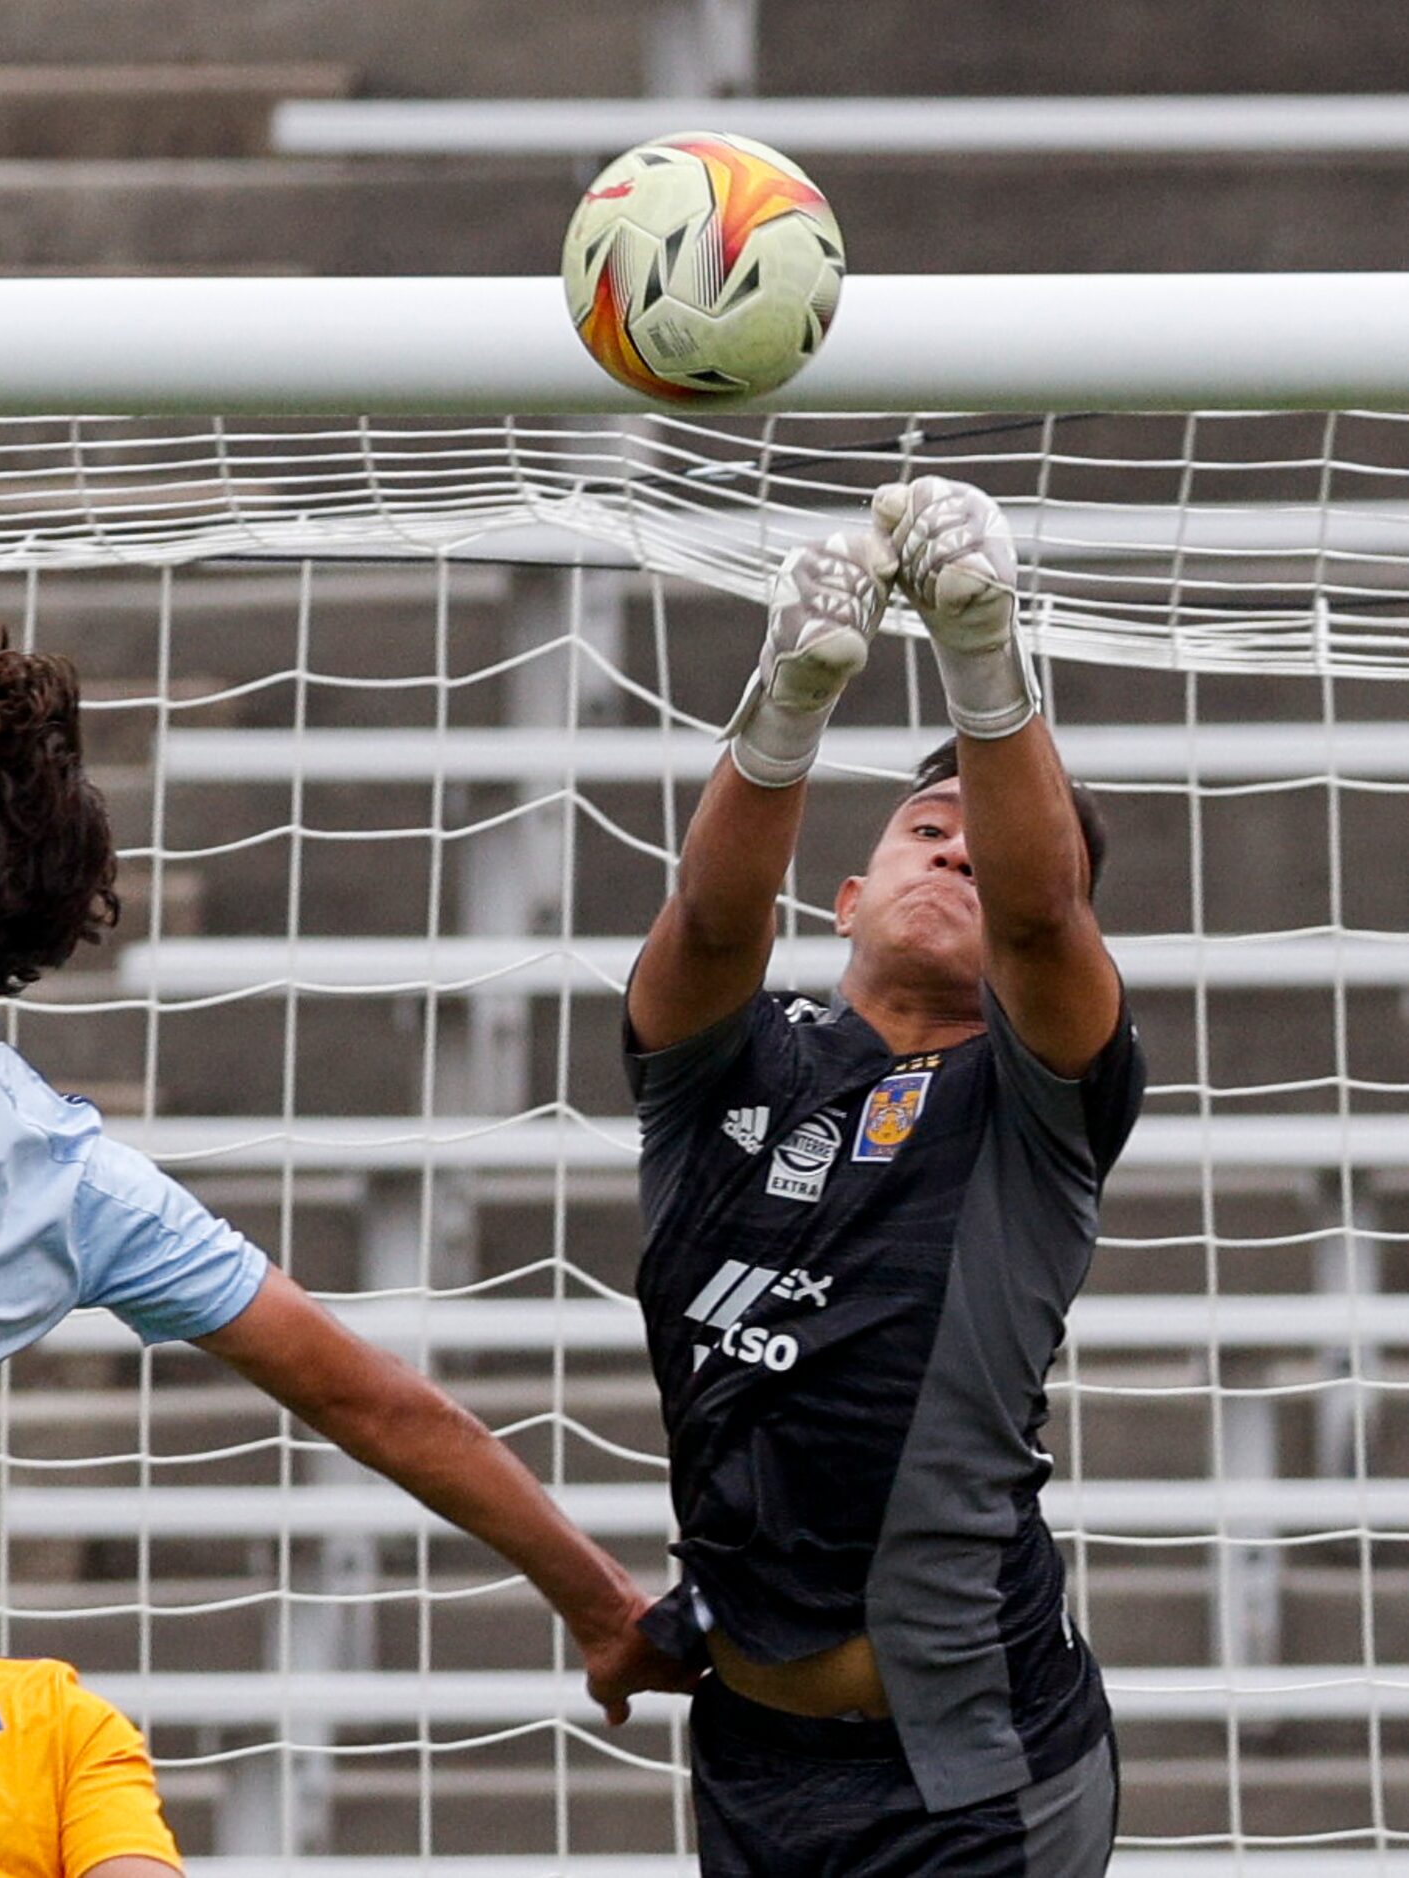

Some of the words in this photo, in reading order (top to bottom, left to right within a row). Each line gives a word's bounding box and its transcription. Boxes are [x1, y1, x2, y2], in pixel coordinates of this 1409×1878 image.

[772, 1176, 820, 1197] EXTRA
[770, 1267, 834, 1307] EX
[713, 1322, 799, 1372] tso
